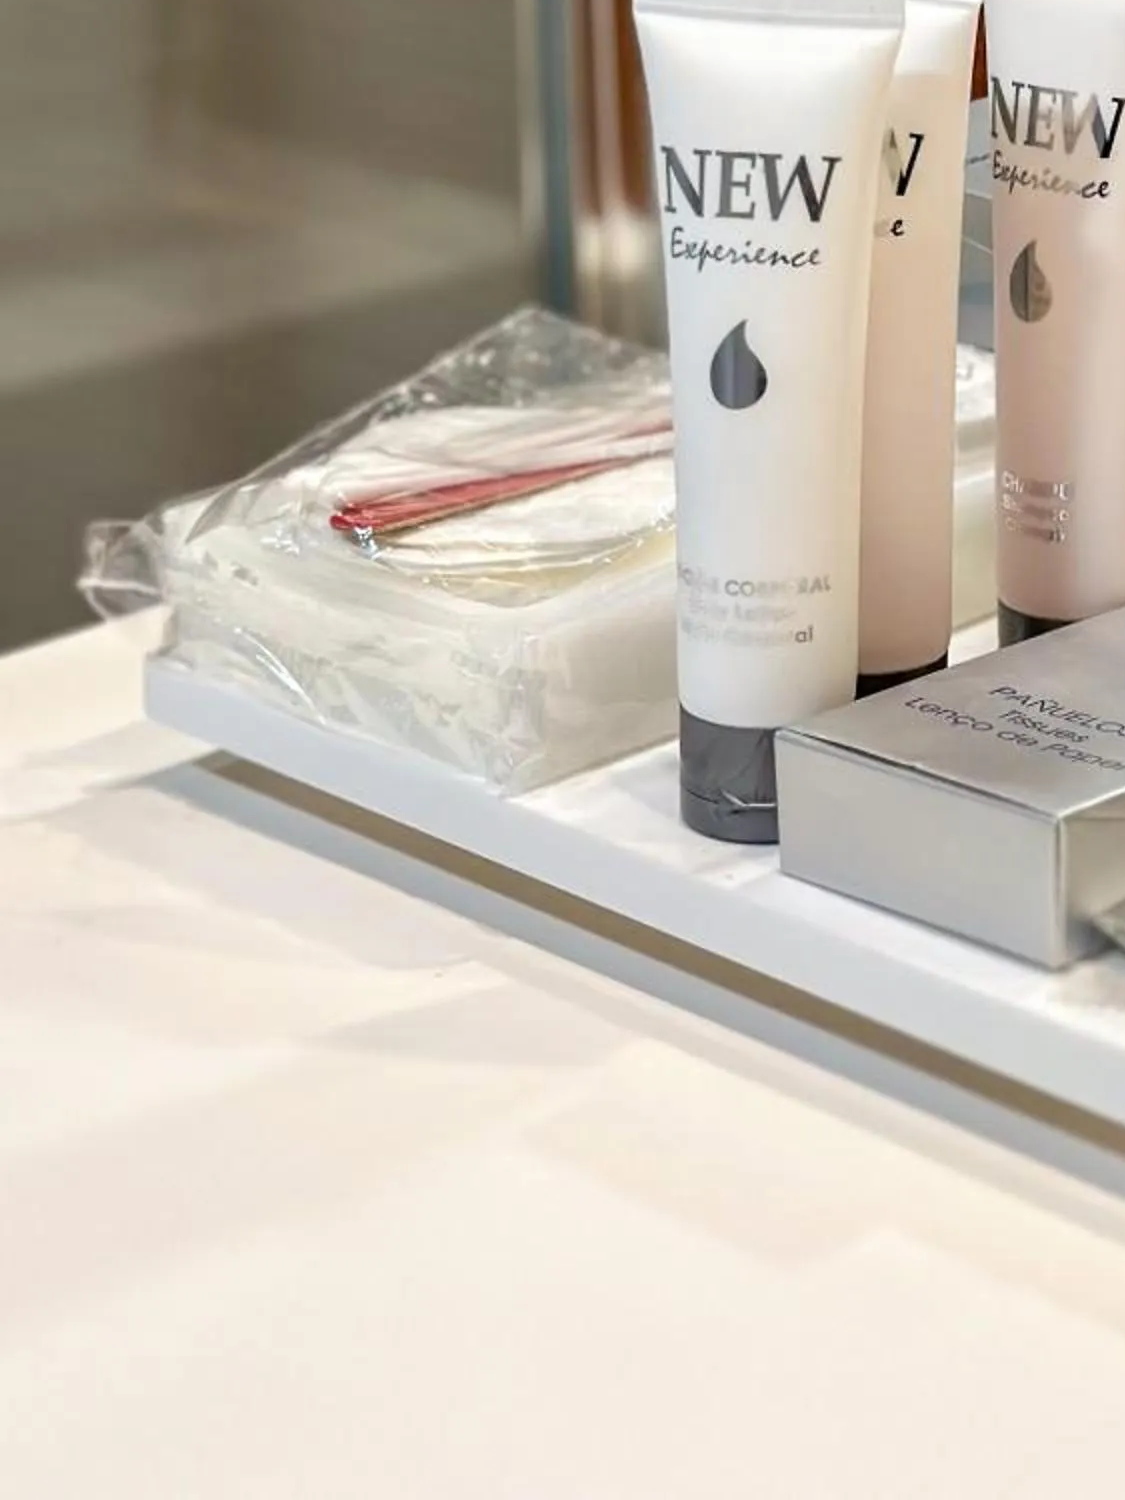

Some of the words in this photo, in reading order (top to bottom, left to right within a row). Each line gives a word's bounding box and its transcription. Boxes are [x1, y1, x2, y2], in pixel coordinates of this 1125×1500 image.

[661, 145, 843, 223] NEW
[991, 150, 1111, 199] Experience
[670, 225, 822, 273] Experience
[996, 730, 1039, 748] de
[999, 709, 1089, 743] Tissues
